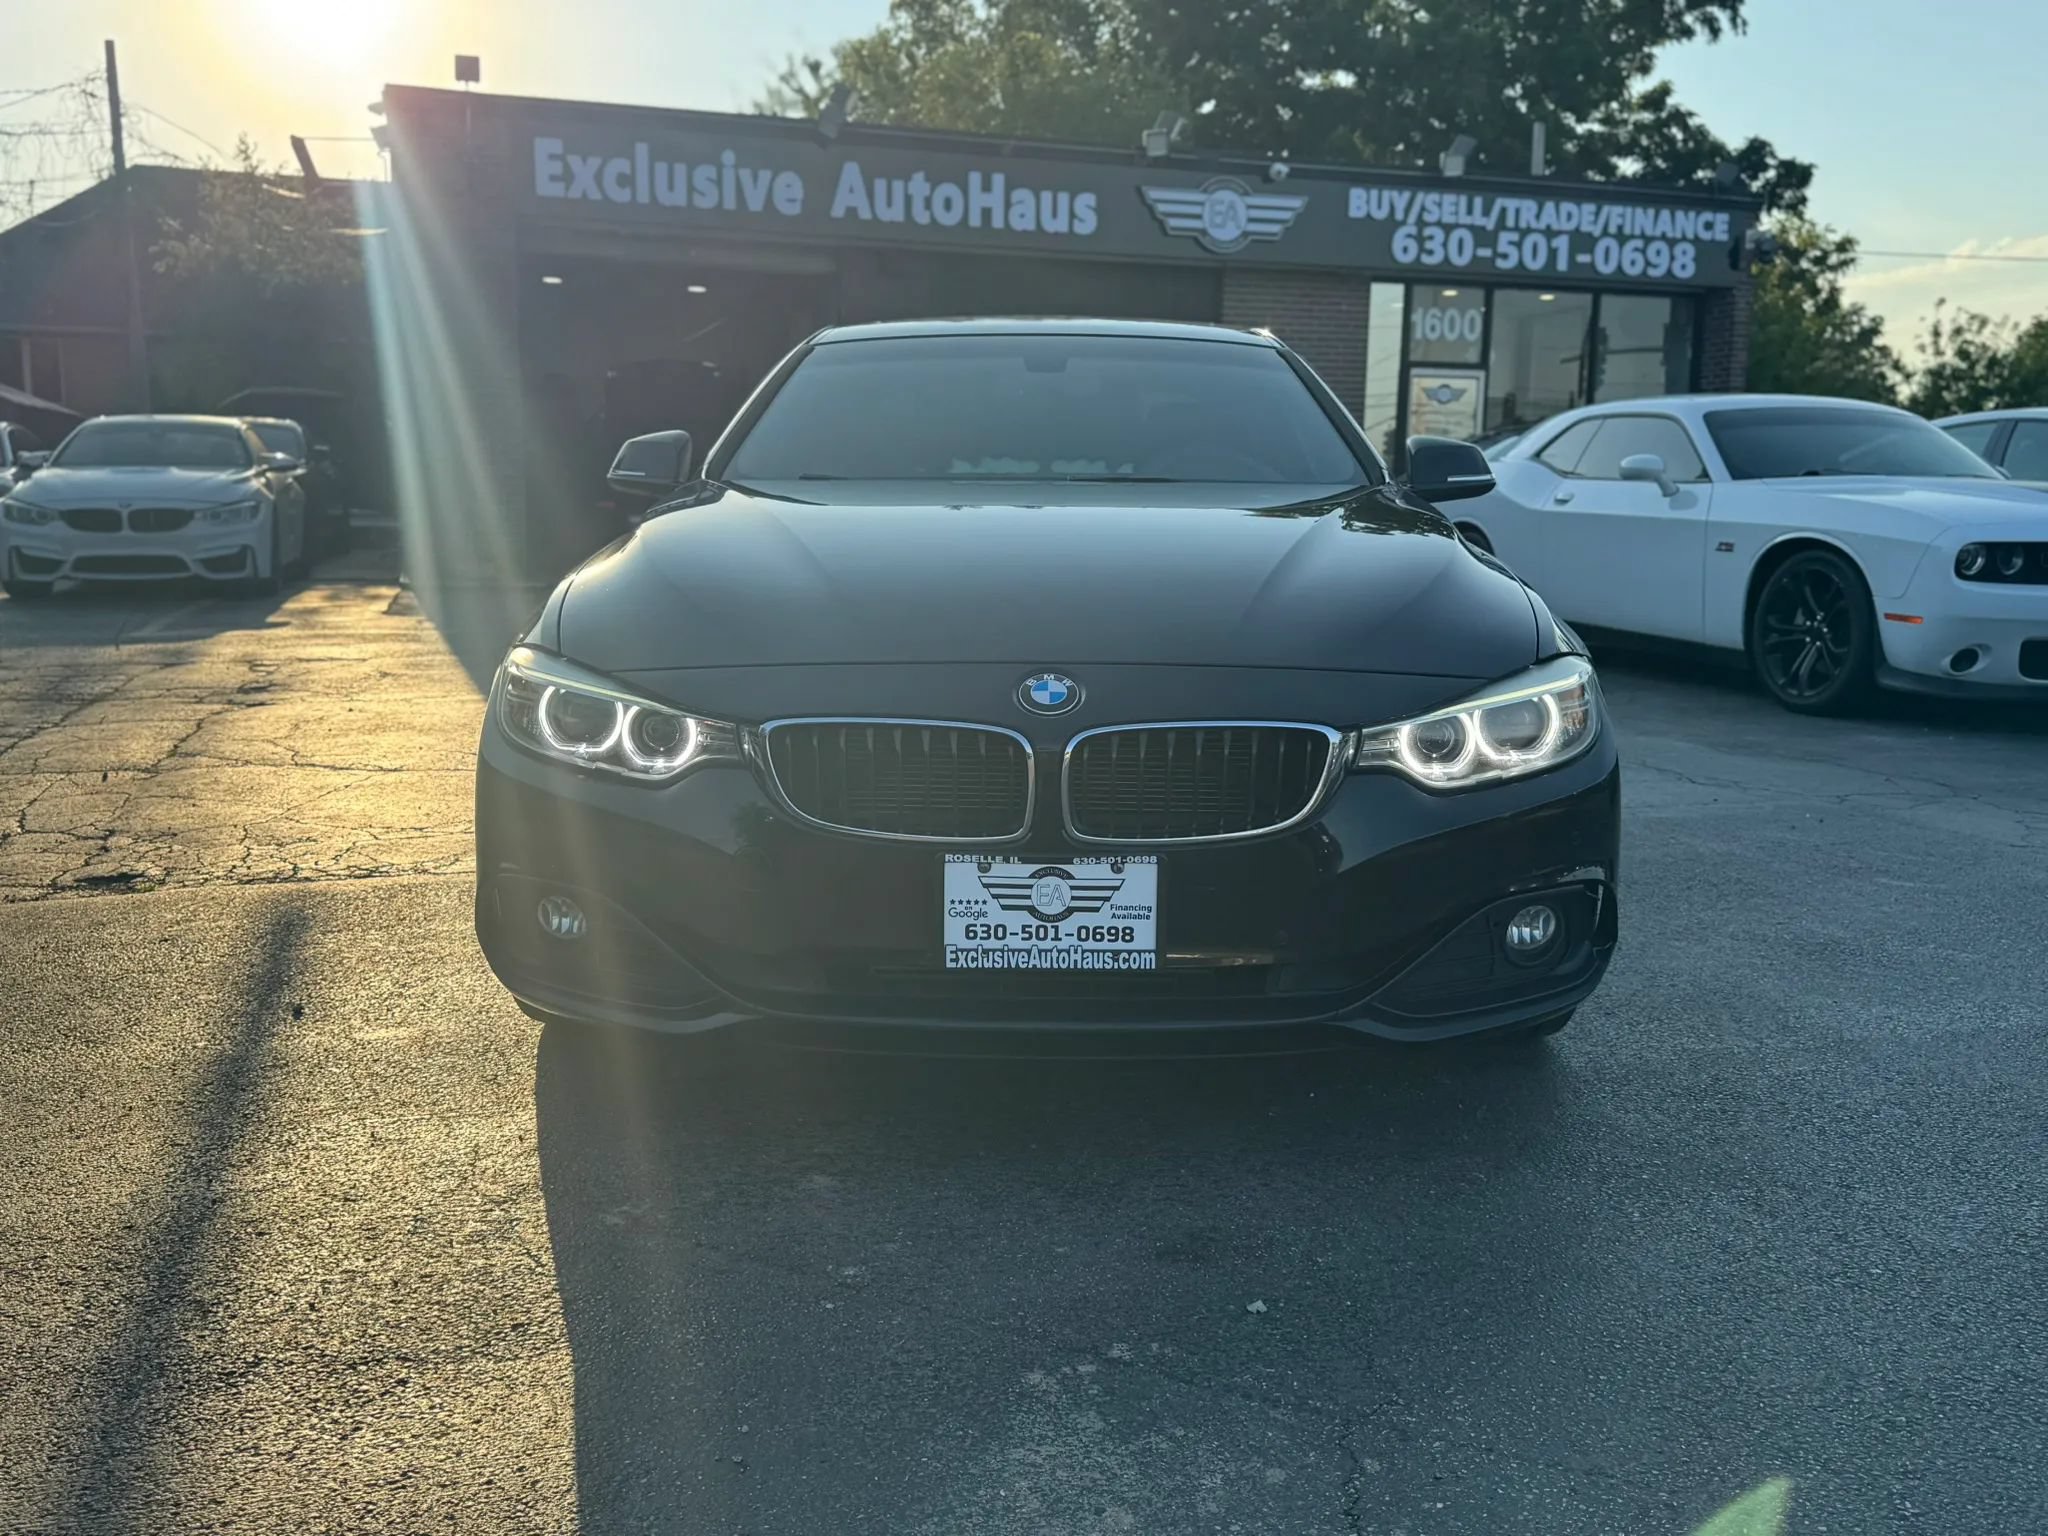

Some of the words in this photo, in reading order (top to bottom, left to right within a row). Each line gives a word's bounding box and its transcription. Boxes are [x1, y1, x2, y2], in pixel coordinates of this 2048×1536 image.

[533, 137, 804, 215] Exclusive
[831, 161, 1099, 236] AutoHaus
[1347, 187, 1730, 242] BUY/SELL/TRADE/FINANCE
[1390, 226, 1697, 279] 630-501-0698
[1411, 307, 1483, 342] 1600
[1026, 674, 1074, 687] BMW
[1009, 856, 1022, 864] IL
[1073, 855, 1158, 865] 630-501-0698
[1036, 883, 1067, 907] EA
[948, 907, 989, 921] Google
[1110, 904, 1152, 913] Financing
[1110, 912, 1151, 920] Available
[964, 923, 1135, 943] 630-501-0698
[945, 944, 1156, 969] ExclusiveAutoHaus.com
